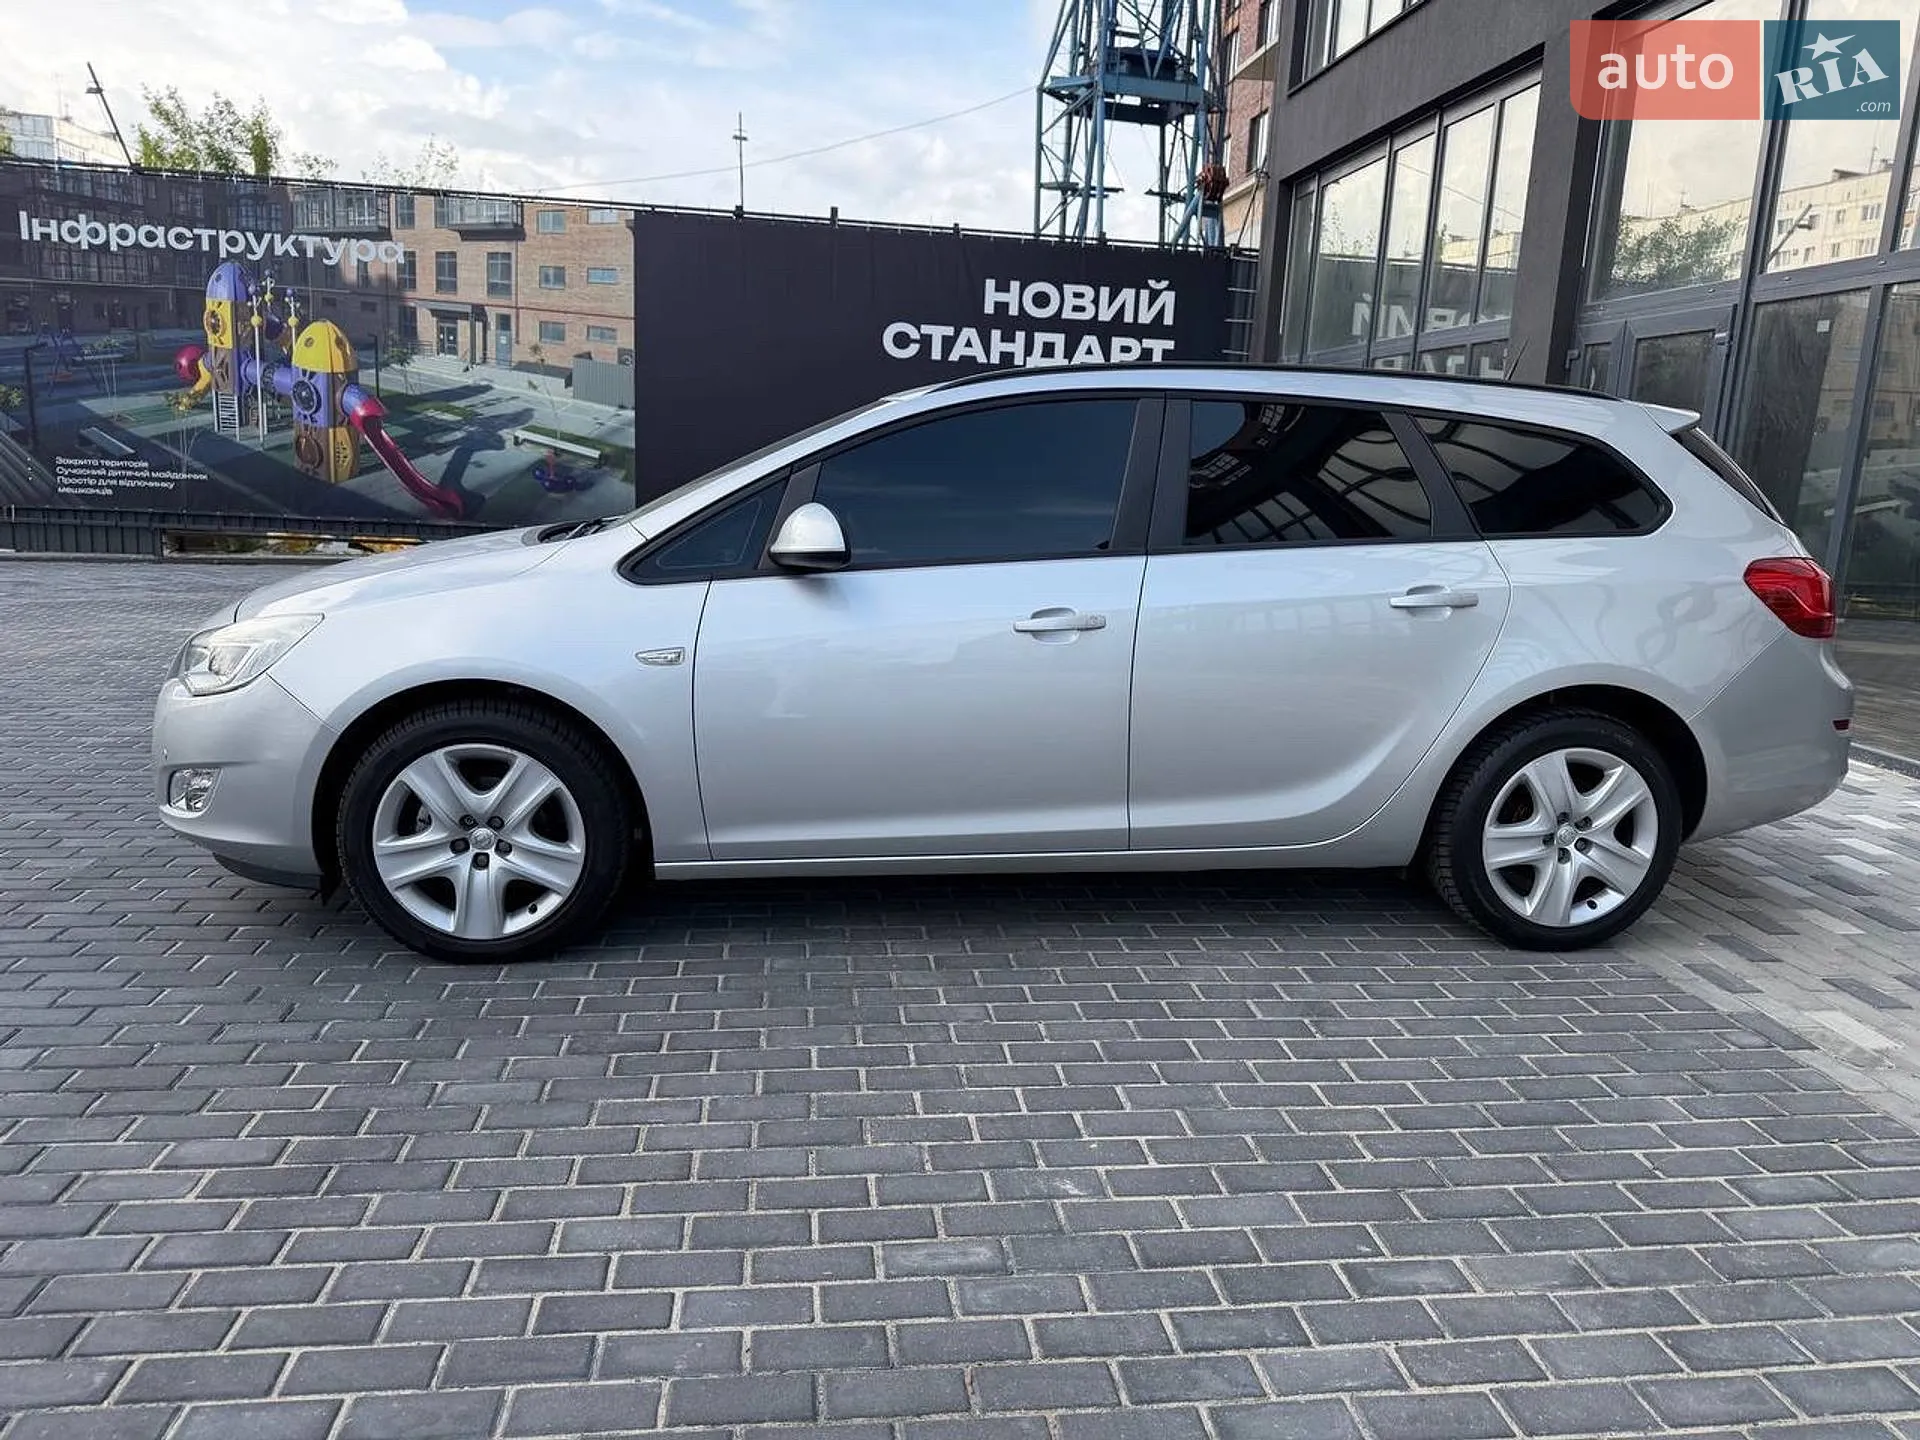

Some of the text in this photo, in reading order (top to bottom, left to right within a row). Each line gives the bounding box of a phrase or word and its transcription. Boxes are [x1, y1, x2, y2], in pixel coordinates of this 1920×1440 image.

[18, 210, 405, 265] Інфраструктура
[984, 278, 1176, 326] НОВИЙ
[882, 322, 1175, 368] СТАНДАРТ
